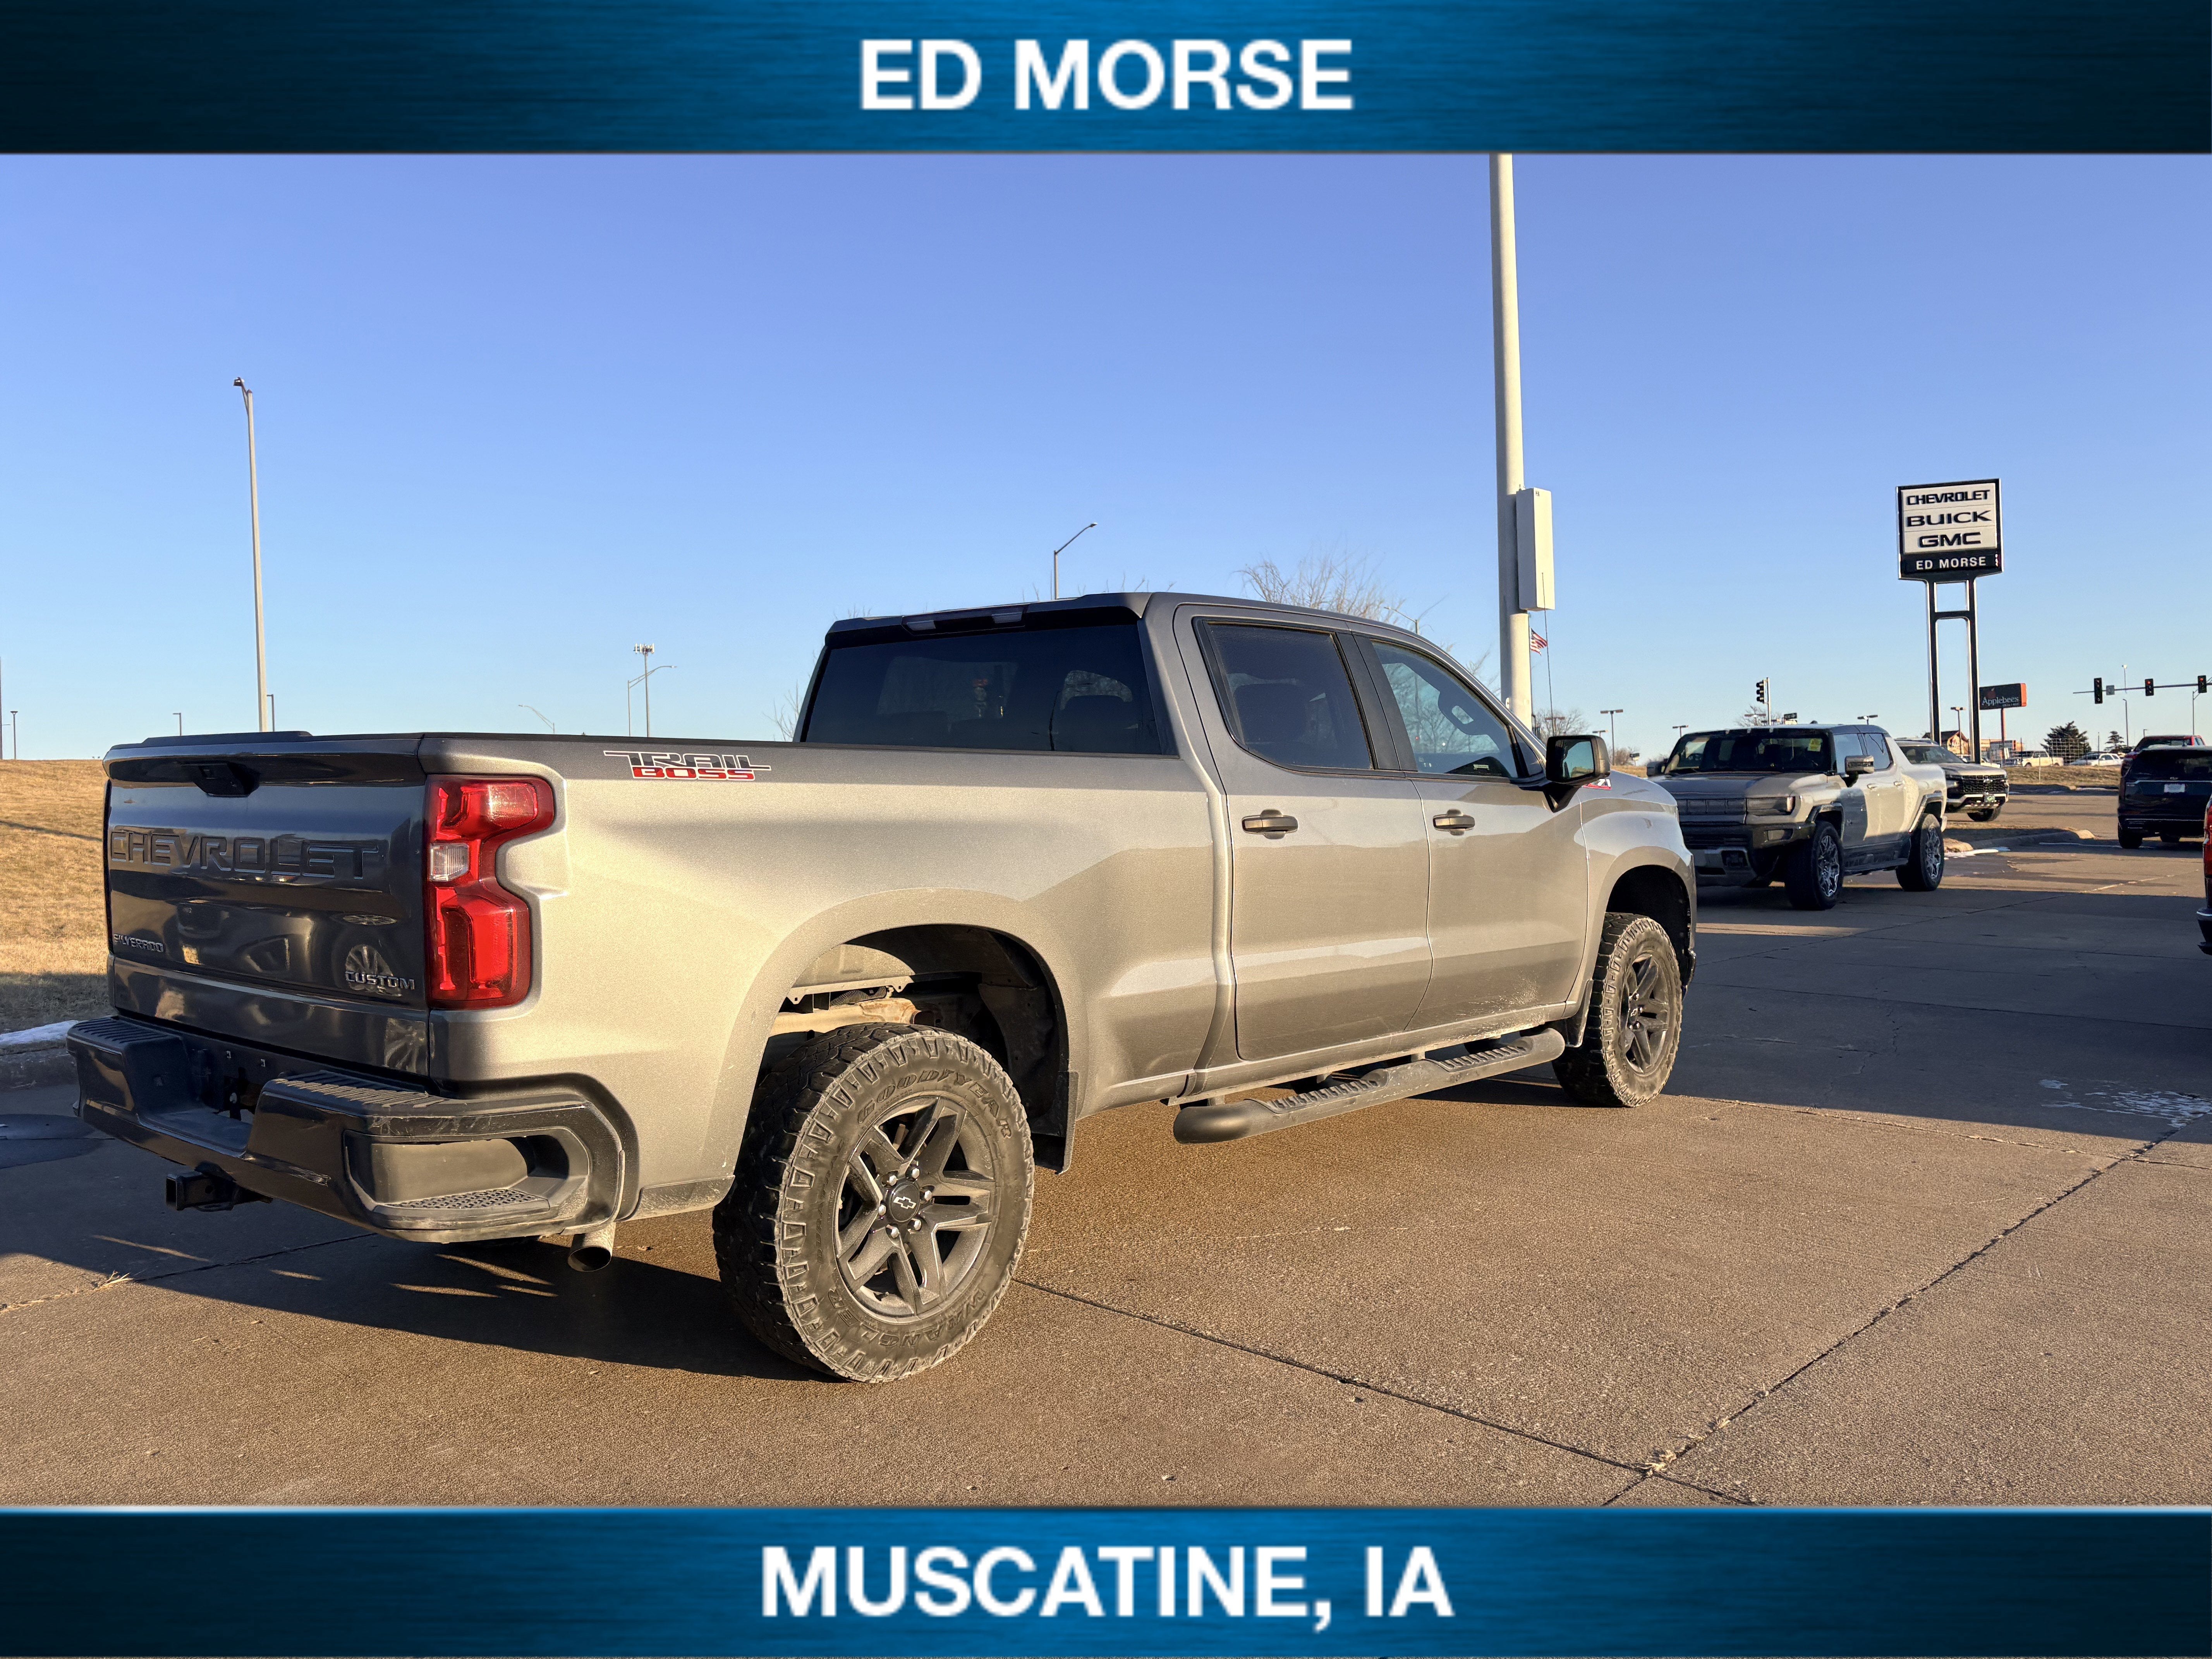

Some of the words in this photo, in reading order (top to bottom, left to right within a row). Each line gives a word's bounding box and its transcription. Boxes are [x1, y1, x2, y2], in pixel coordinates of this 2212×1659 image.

[1906, 490, 1990, 505] CHEVROLET
[1907, 510, 1992, 527] BUICK
[1919, 532, 1981, 548] GMC
[1916, 560, 1933, 570] ED
[1939, 556, 1986, 568] MORSE
[603, 750, 772, 771] TRAIL
[632, 766, 756, 781] BOSS
[111, 831, 380, 880] CHEVROLET
[113, 934, 164, 952] SILVERADO
[345, 971, 415, 990] CUSTOM
[857, 1070, 1012, 1139] GOODYEAR
